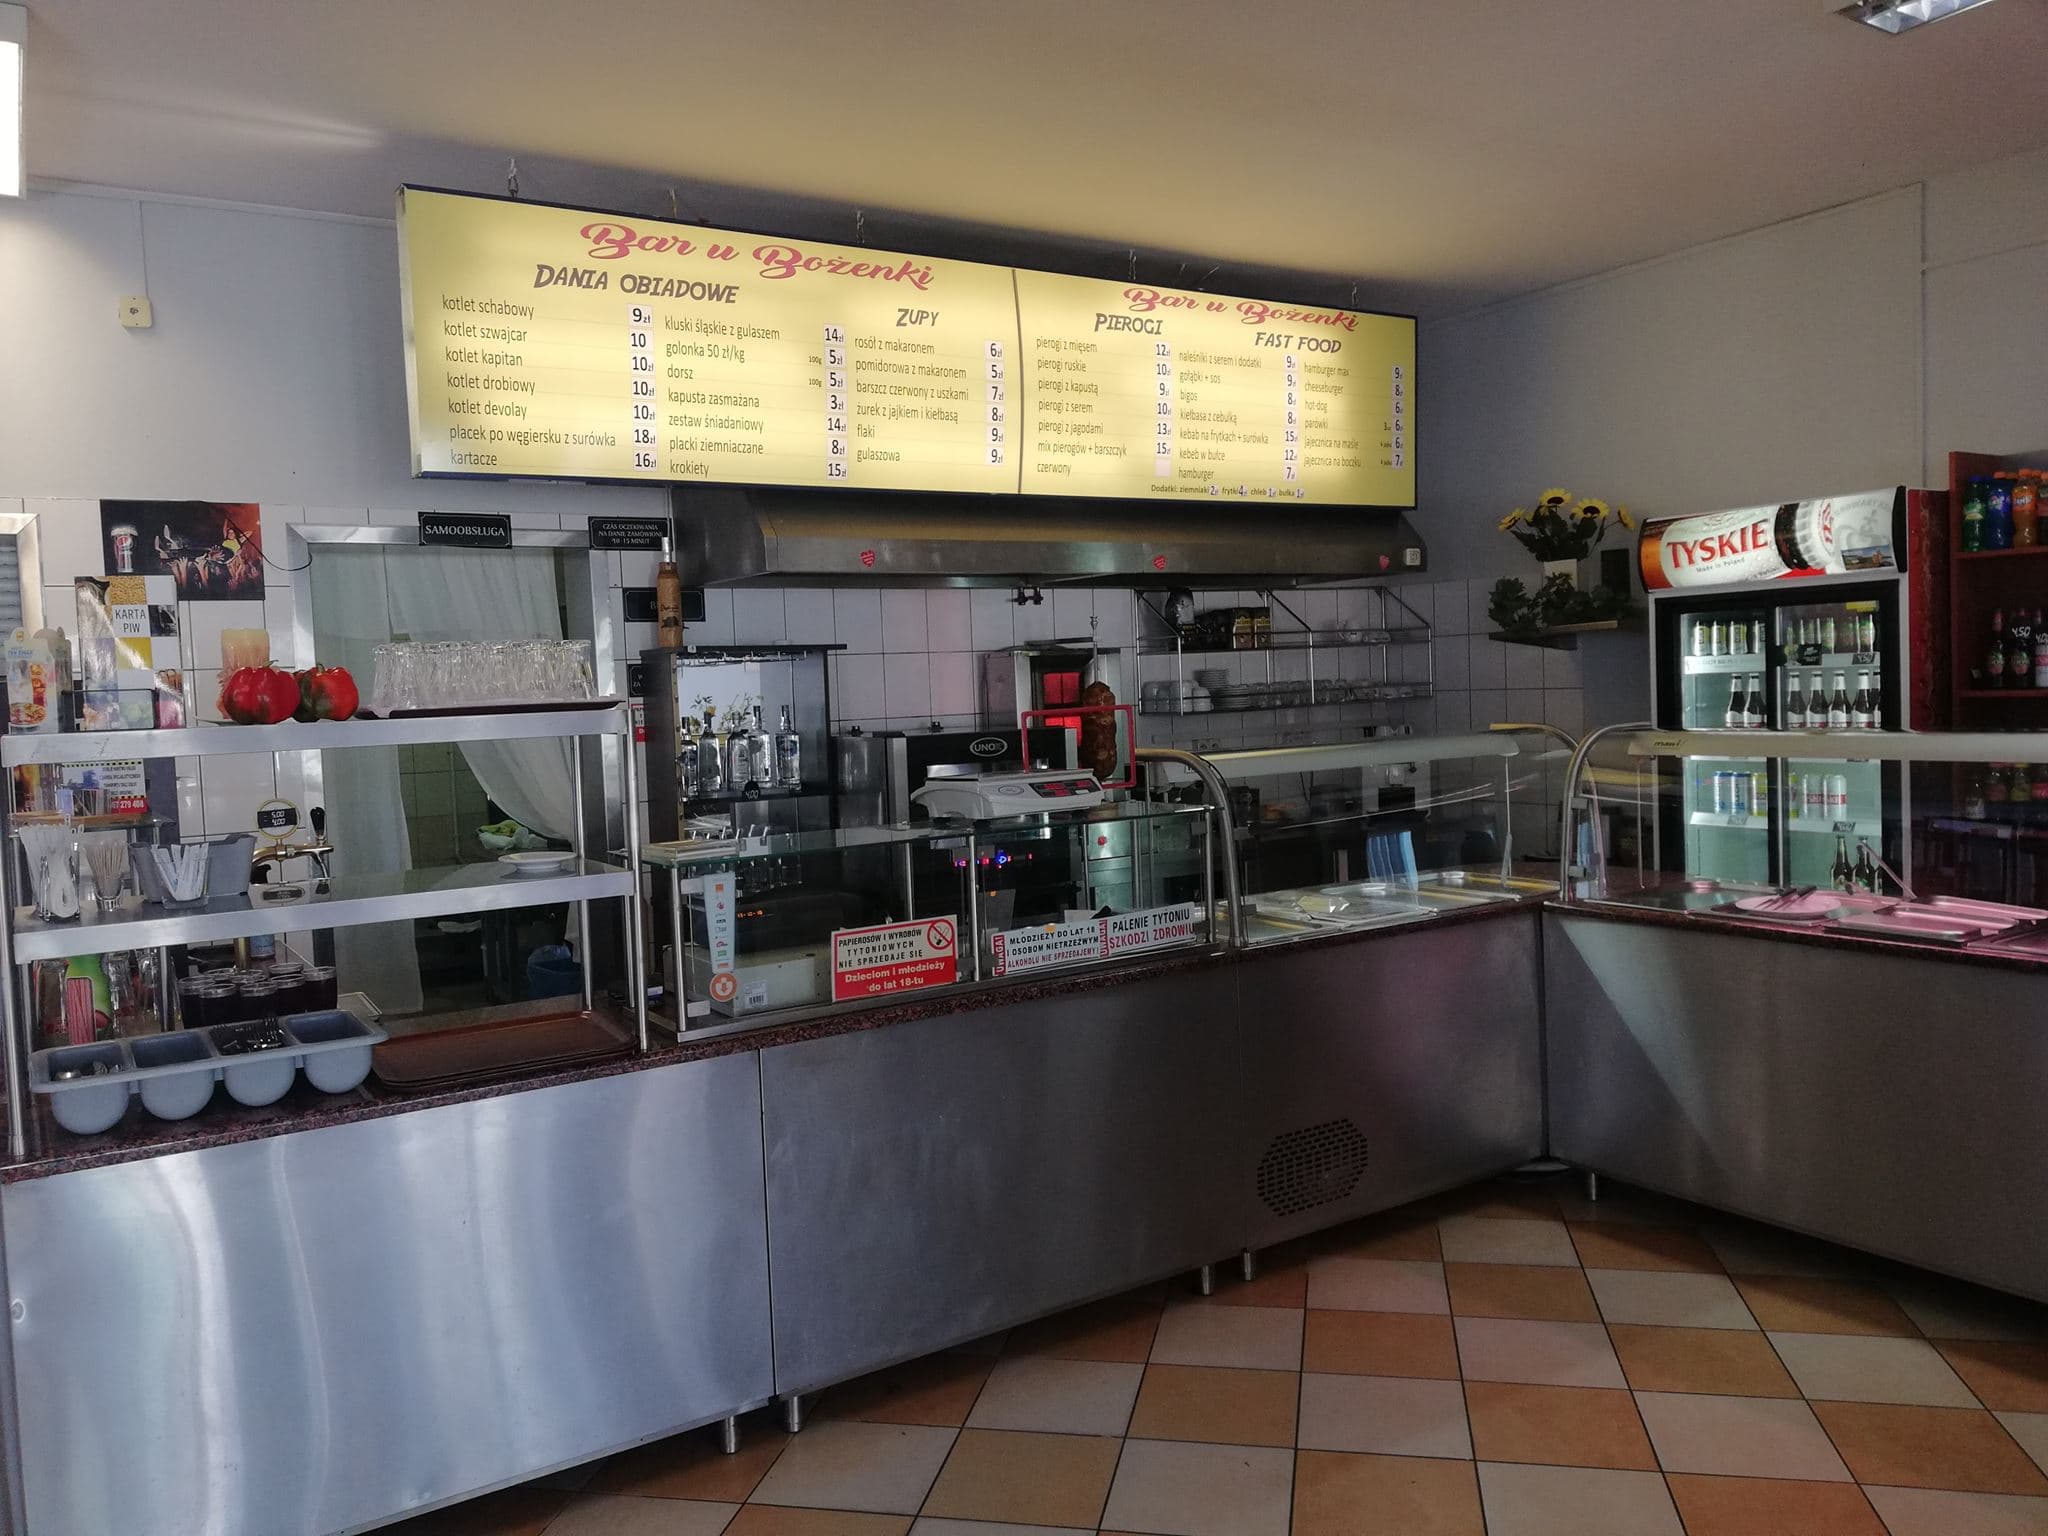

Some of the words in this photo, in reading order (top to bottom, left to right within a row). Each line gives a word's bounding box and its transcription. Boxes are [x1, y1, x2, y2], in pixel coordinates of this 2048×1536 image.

[581, 223, 696, 259] Bar
[706, 244, 739, 260] u
[752, 245, 935, 290] Bożenki
[534, 264, 608, 290] DANIA
[620, 274, 739, 304] OBIADOWE
[442, 294, 475, 312] kotlet
[479, 297, 534, 320] schabowy
[1123, 287, 1199, 312] Bar
[1206, 300, 1228, 312] u
[1236, 301, 1359, 332] Bożenki
[896, 308, 939, 327] ZUPY
[1095, 312, 1163, 334] PIEROGI
[444, 319, 476, 338] kotlet
[480, 322, 527, 344] szwajcar
[665, 316, 692, 333] kluski
[696, 318, 727, 338] śląskie
[737, 325, 779, 340] gulaszem
[631, 333, 646, 348] 10
[666, 339, 704, 358] golonka
[708, 342, 719, 357] 50
[722, 342, 744, 361] zł/kg
[855, 336, 876, 350] rosół
[885, 338, 934, 354] makaronem
[1255, 332, 1293, 349] FAST
[1298, 336, 1342, 354] FOOD
[446, 346, 478, 364] kotlet
[482, 348, 522, 369] kapitan
[1038, 357, 1063, 371] pierogi
[1064, 359, 1086, 372] ruskie
[667, 363, 693, 380] dorsz
[856, 359, 909, 377] pomidorowa
[918, 365, 966, 379] makaronem
[447, 372, 479, 390] kotlet
[483, 374, 535, 395] drobiowy
[856, 380, 886, 394] barszcz
[889, 385, 928, 399] czerwony
[937, 385, 968, 400] uszkami
[668, 387, 706, 406] kapusta
[709, 390, 759, 408] zasmażana
[1039, 398, 1064, 412] pierogi
[1071, 404, 1093, 413] serem
[449, 398, 480, 416] kotlet
[485, 400, 527, 420] devolay
[857, 401, 880, 415] żurek
[888, 404, 918, 420] jajkiem
[925, 405, 958, 421] kiełbasą
[669, 411, 702, 426] zestaw
[705, 413, 763, 431] śniadaniowy
[450, 424, 486, 443] placek
[490, 429, 503, 444] po
[507, 426, 561, 446] węgiersku
[573, 428, 616, 446] surówka
[857, 425, 875, 438] flaki
[670, 436, 698, 453] placki
[701, 437, 763, 454] ziemniaczane
[857, 447, 900, 463] gulaszowa
[451, 448, 497, 466] kartacze
[670, 459, 709, 477] krokiety
[1178, 467, 1214, 480] hamburger
[1667, 519, 1770, 568] TYSKIE
[115, 609, 146, 619] KARTA
[124, 623, 140, 632] PIW
[1112, 916, 1148, 933] PALENIE
[1152, 908, 1190, 925] TYTONIU
[839, 934, 881, 946] PAPIEROSÓW
[888, 929, 921, 939] WYROBÓW
[1070, 928, 1084, 937] LAT
[1109, 932, 1148, 949] SZKODZI
[1153, 924, 1194, 941] ZDROWIU
[848, 941, 914, 957] TYTONIOWYCH
[1013, 946, 1044, 956] OSOBOM
[839, 960, 852, 969] NIE
[857, 953, 904, 966] SPRZEDAJE
[1008, 957, 1039, 968] ALKOHOLU
[1042, 954, 1052, 962] NIE
[845, 969, 890, 983] Dzieciom
[899, 961, 944, 974] młodzieży
[869, 982, 881, 992] do
[884, 981, 896, 989] lat
[901, 976, 923, 987] 18-tu
